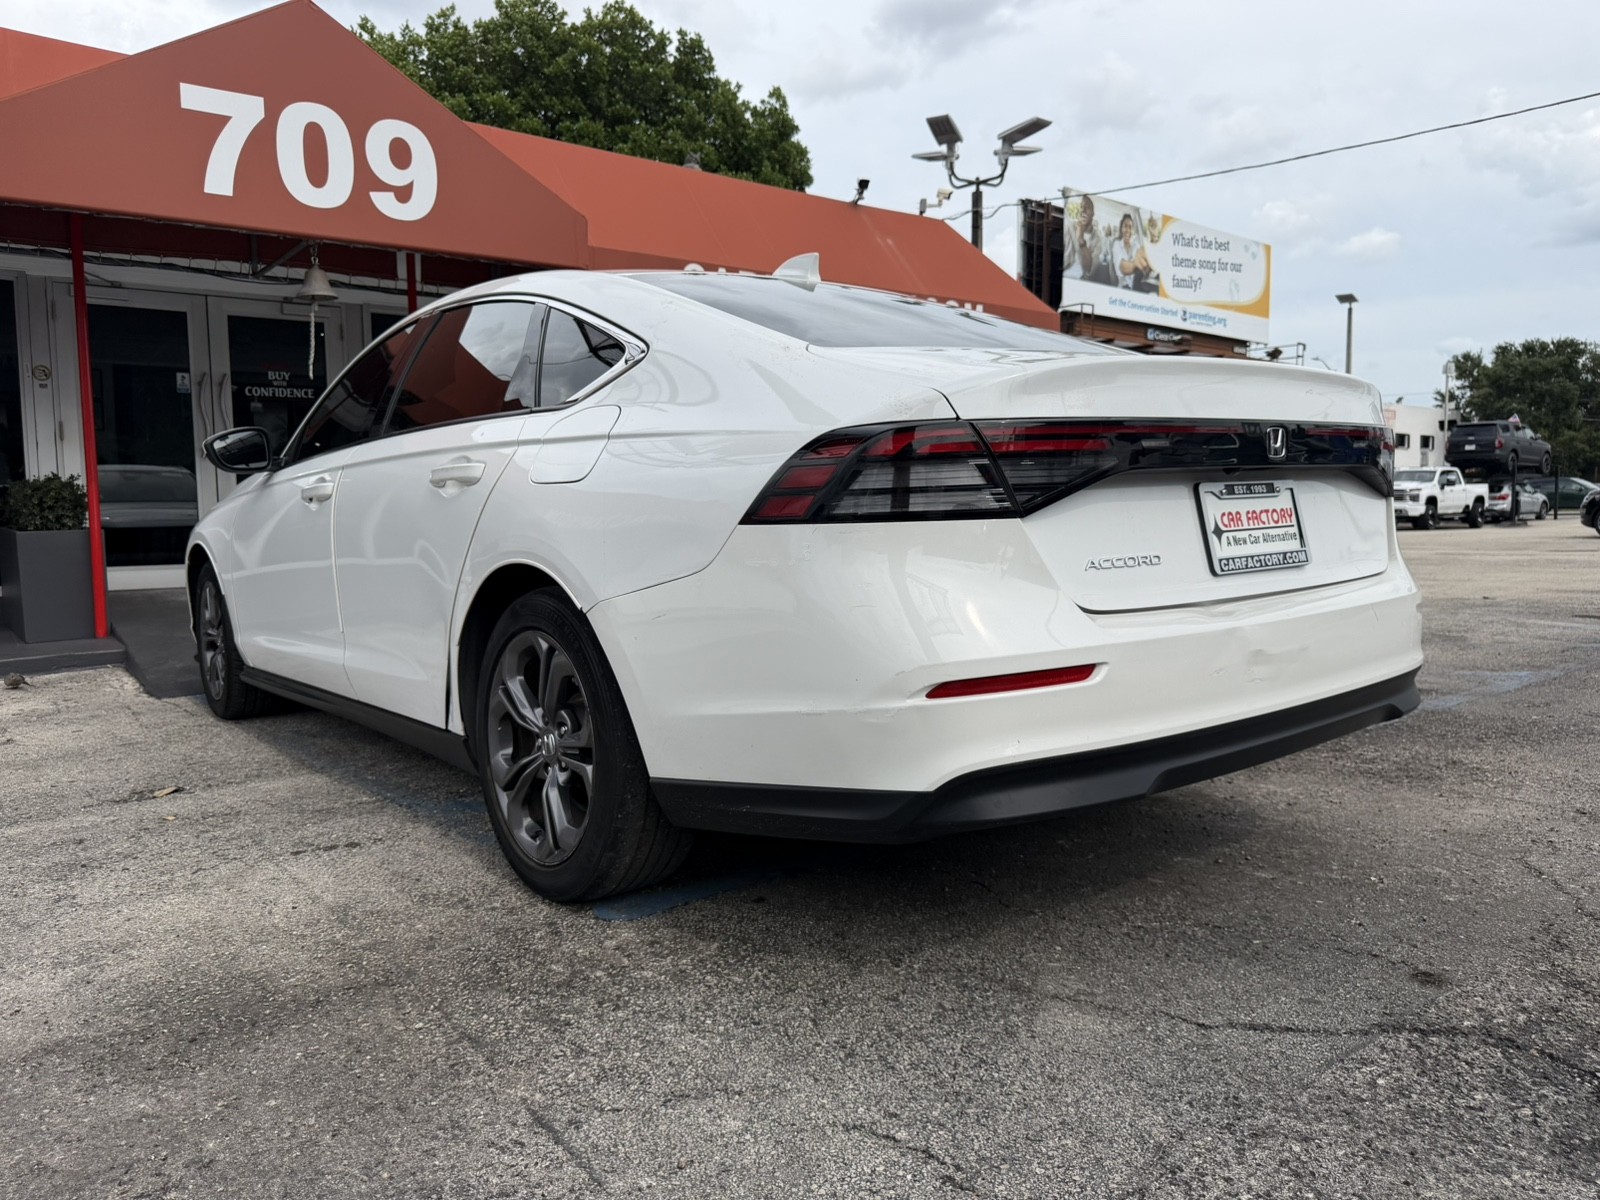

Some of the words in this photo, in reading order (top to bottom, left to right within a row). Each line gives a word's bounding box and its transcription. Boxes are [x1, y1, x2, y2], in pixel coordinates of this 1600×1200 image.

[180, 82, 438, 221] 709
[1172, 232, 1199, 249] What's
[1201, 235, 1213, 250] the
[1214, 237, 1230, 252] best
[1172, 253, 1197, 269] theme
[1198, 258, 1217, 274] song
[1217, 257, 1229, 272] for
[1230, 263, 1243, 273] our
[1172, 274, 1202, 292] family?
[267, 371, 291, 381] BUY
[244, 386, 315, 399] CONFIDENCE
[1234, 485, 1250, 494] EST.
[1220, 510, 1244, 529] CAR
[1245, 507, 1293, 527] FACTORY
[1226, 535, 1232, 547] A
[1232, 534, 1247, 546] New
[1248, 533, 1261, 545] Car
[1262, 530, 1298, 544] Alternative
[1084, 554, 1162, 572] ACCORD
[1220, 551, 1307, 571] CARFACTORY.COM
